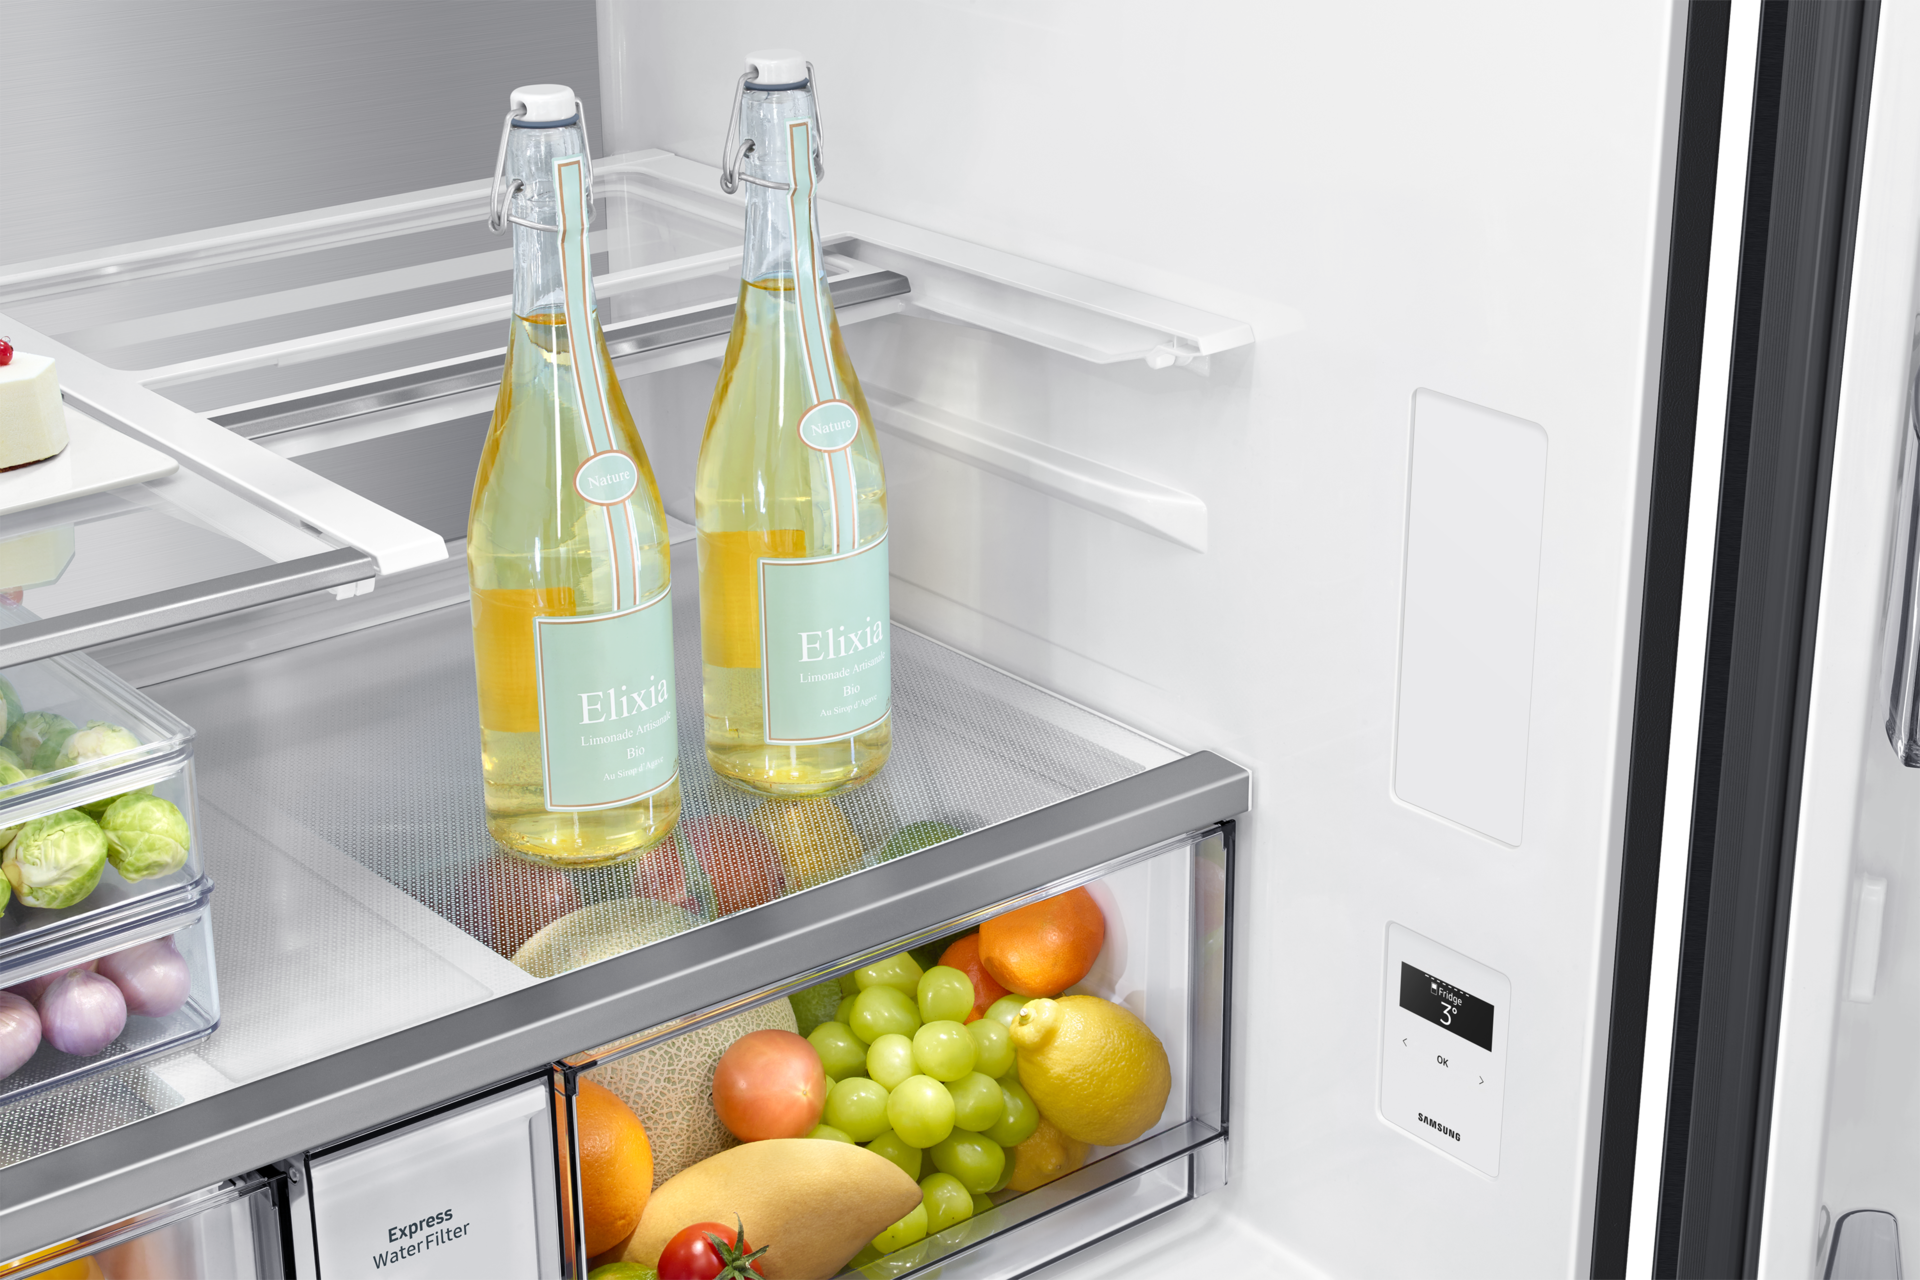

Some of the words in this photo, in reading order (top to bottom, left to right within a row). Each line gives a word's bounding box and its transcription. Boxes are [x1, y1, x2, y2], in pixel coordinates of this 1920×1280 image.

[811, 418, 852, 436] Nature
[588, 469, 630, 489] Nature
[797, 616, 883, 662] Elixia
[800, 667, 850, 683] Limonade
[843, 684, 860, 697] Bio
[578, 675, 669, 725] Elixia
[820, 709, 832, 717] Au
[833, 706, 853, 715] Sirop
[581, 728, 634, 747] Limonade
[627, 746, 645, 759] Bio
[603, 773, 615, 781] Au
[617, 767, 638, 778] Sirop
[1438, 987, 1463, 1006] Fridge
[1436, 1055, 1449, 1068] OK
[1418, 1112, 1461, 1142] SAMSUNG
[388, 1208, 453, 1243] Express
